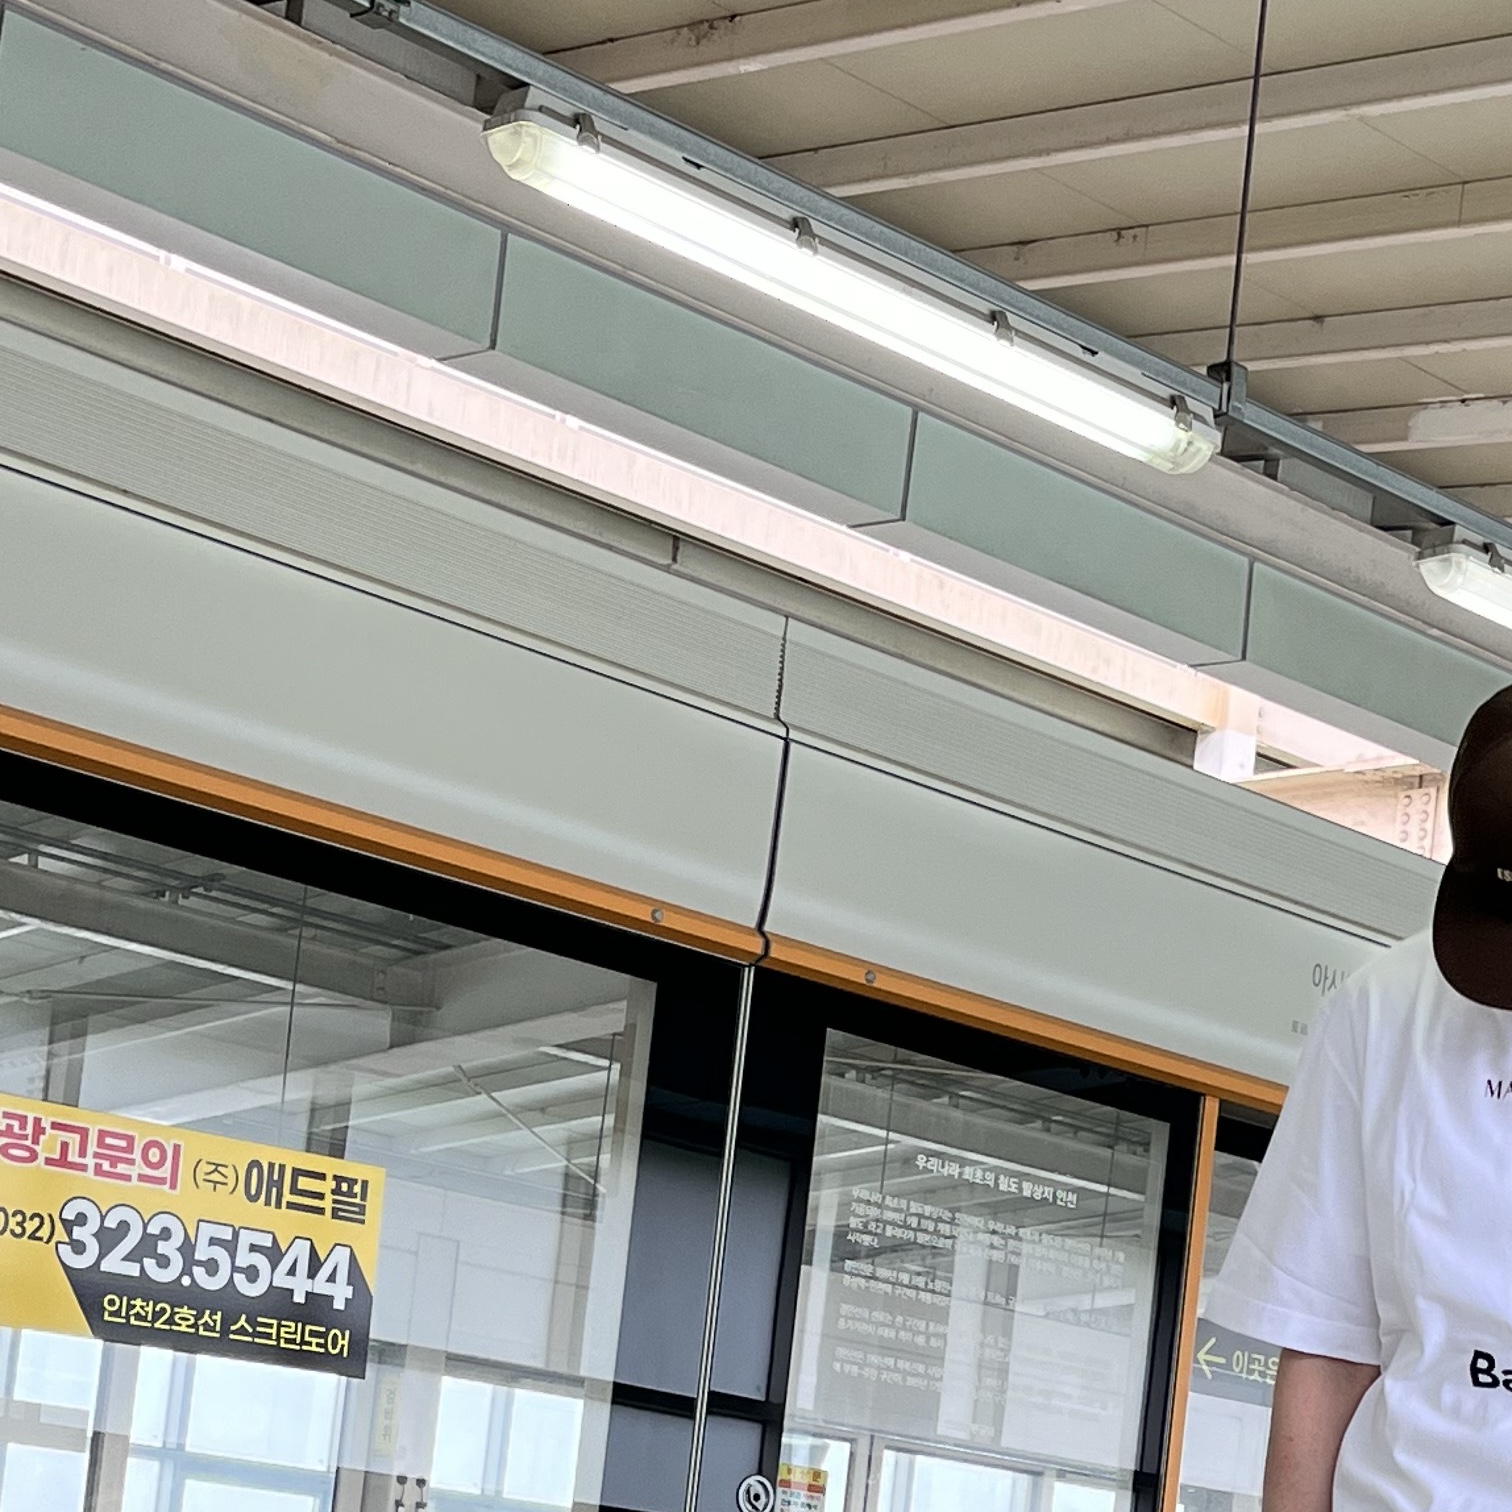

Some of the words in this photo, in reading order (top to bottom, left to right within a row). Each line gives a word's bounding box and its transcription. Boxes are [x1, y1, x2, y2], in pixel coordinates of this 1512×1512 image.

[1312, 963, 1350, 996] 아시
[0, 1111, 182, 1191] 광고문의
[915, 1153, 961, 1180] 우리나라
[55, 1196, 355, 1312] 323.5544
[102, 1293, 223, 1338] 인천2호선
[228, 1312, 351, 1359] 스크린도어
